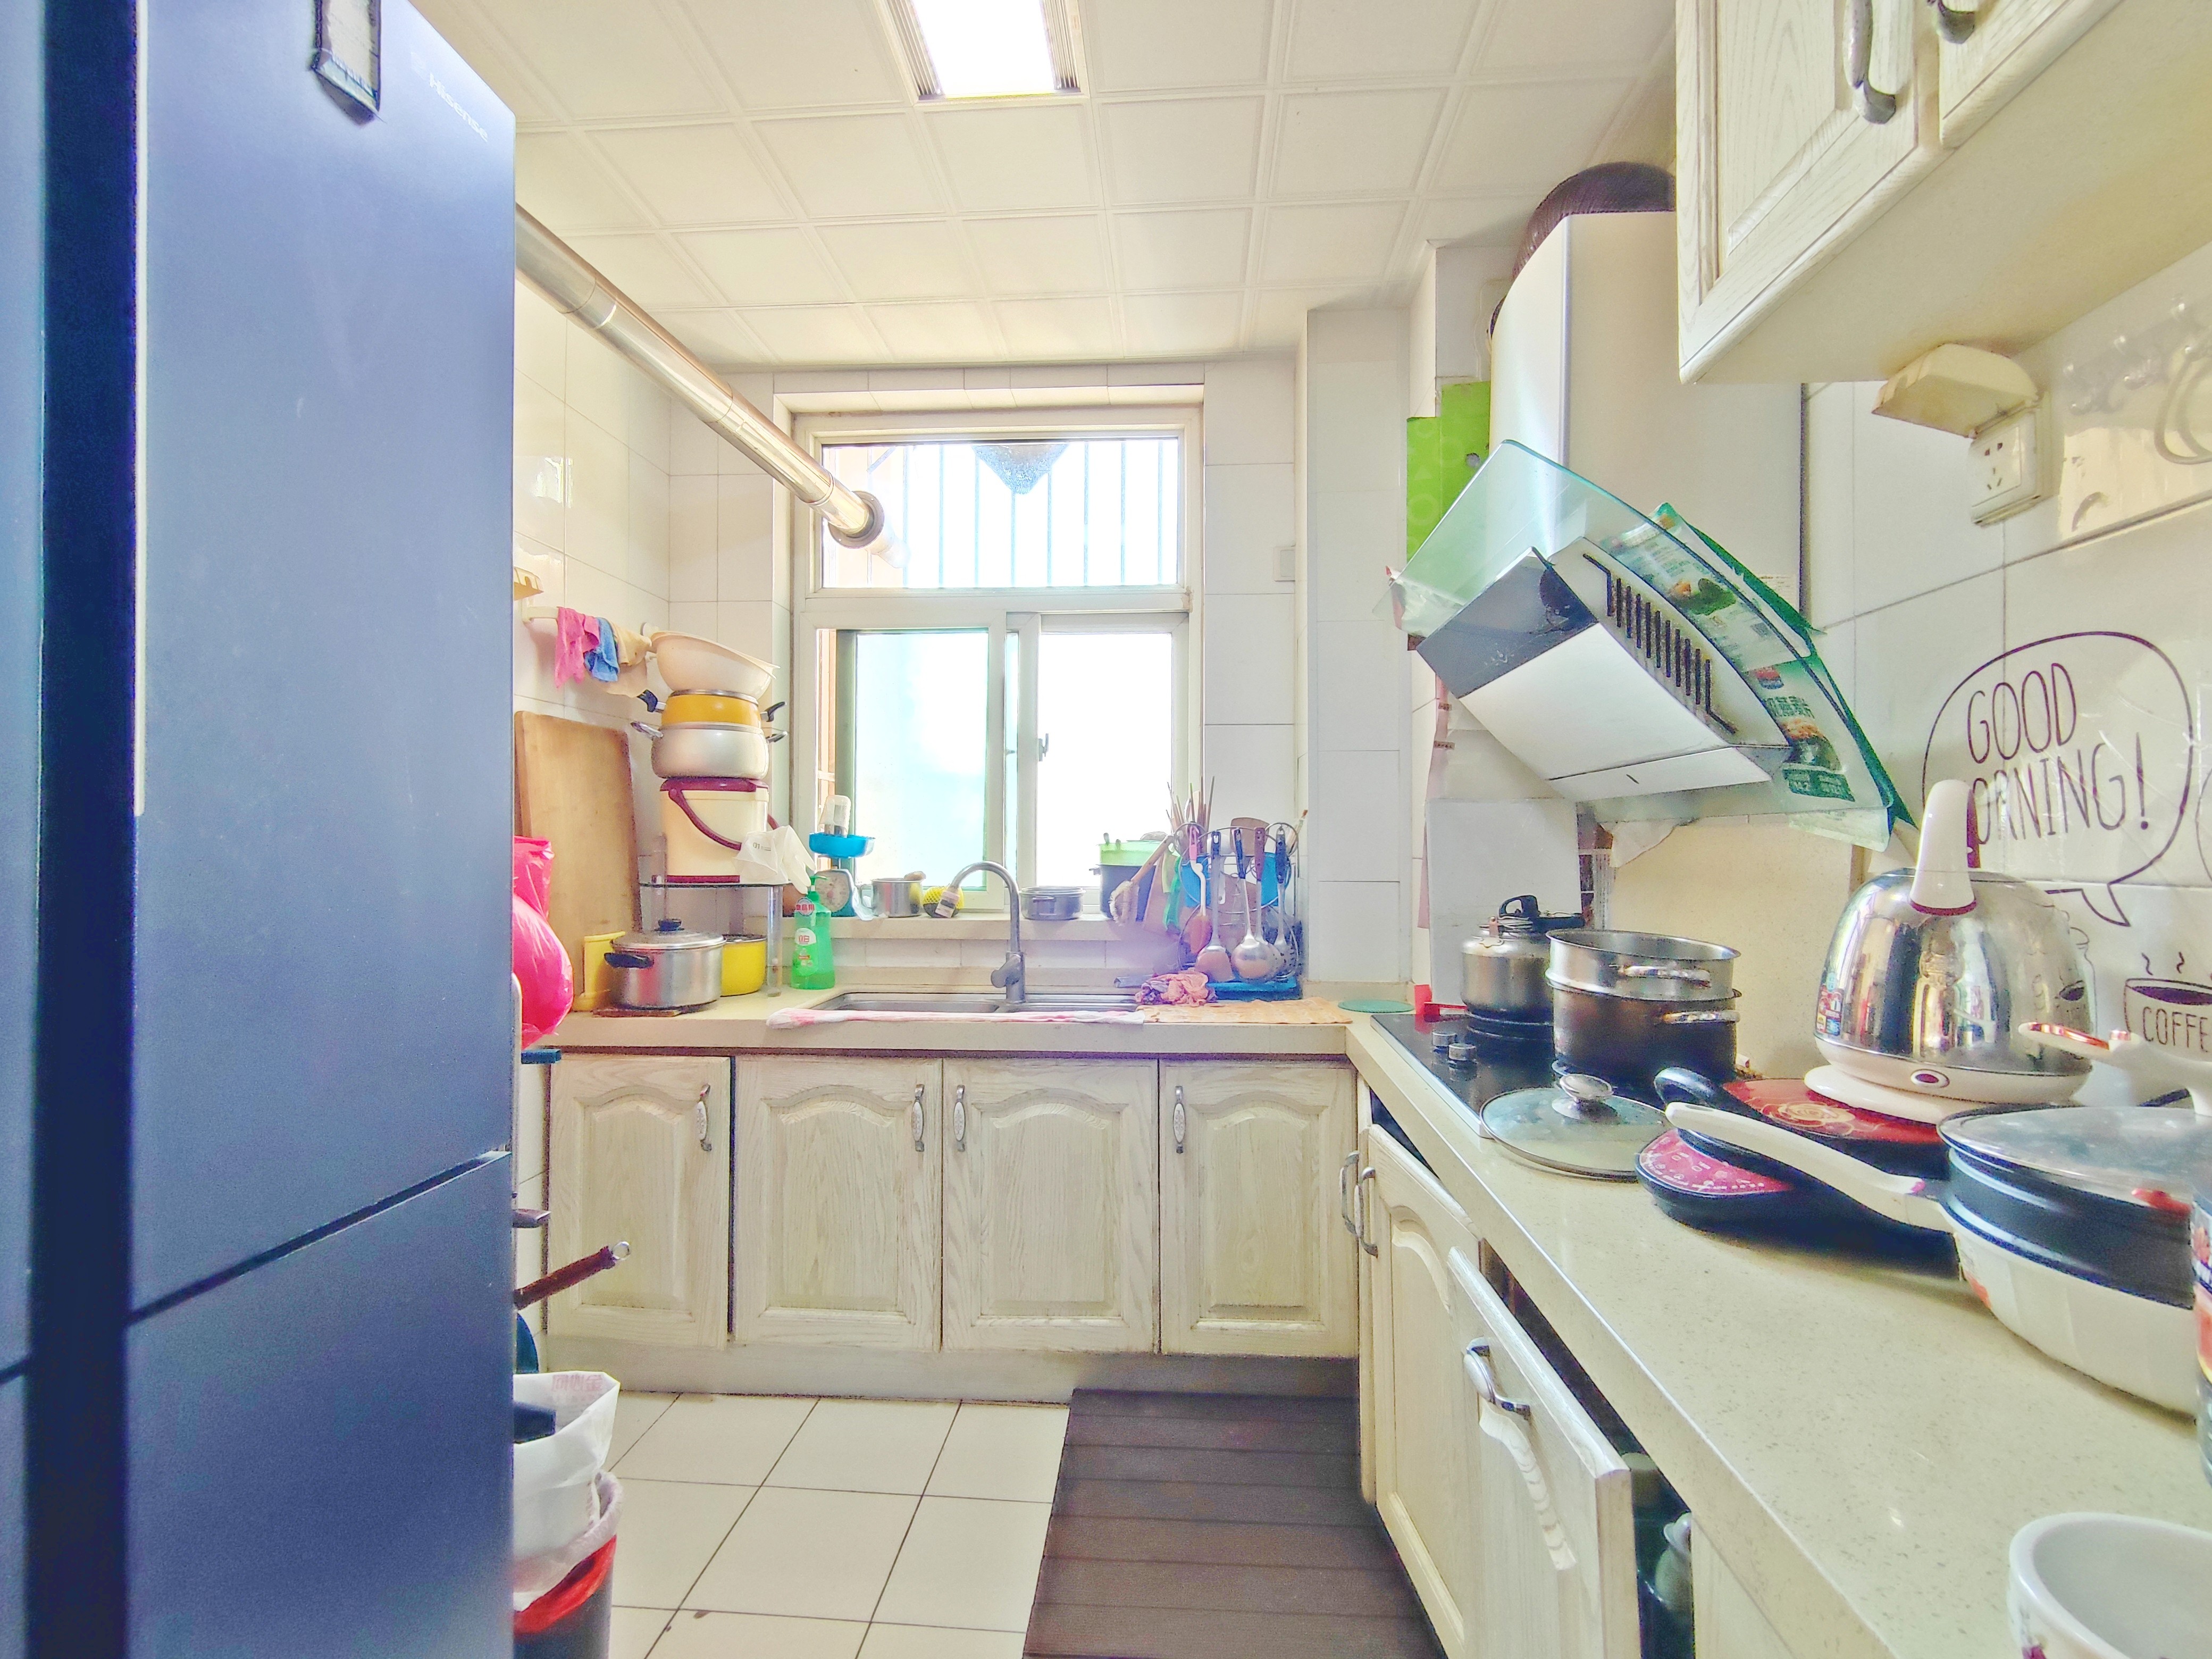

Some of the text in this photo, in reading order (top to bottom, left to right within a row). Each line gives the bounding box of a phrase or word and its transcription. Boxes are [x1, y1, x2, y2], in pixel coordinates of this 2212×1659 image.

[429, 73, 488, 143] Hisense
[1967, 662, 2077, 764] GOOD
[1972, 731, 2149, 845] ORNING!
[2142, 1006, 2209, 1053] COFFE
